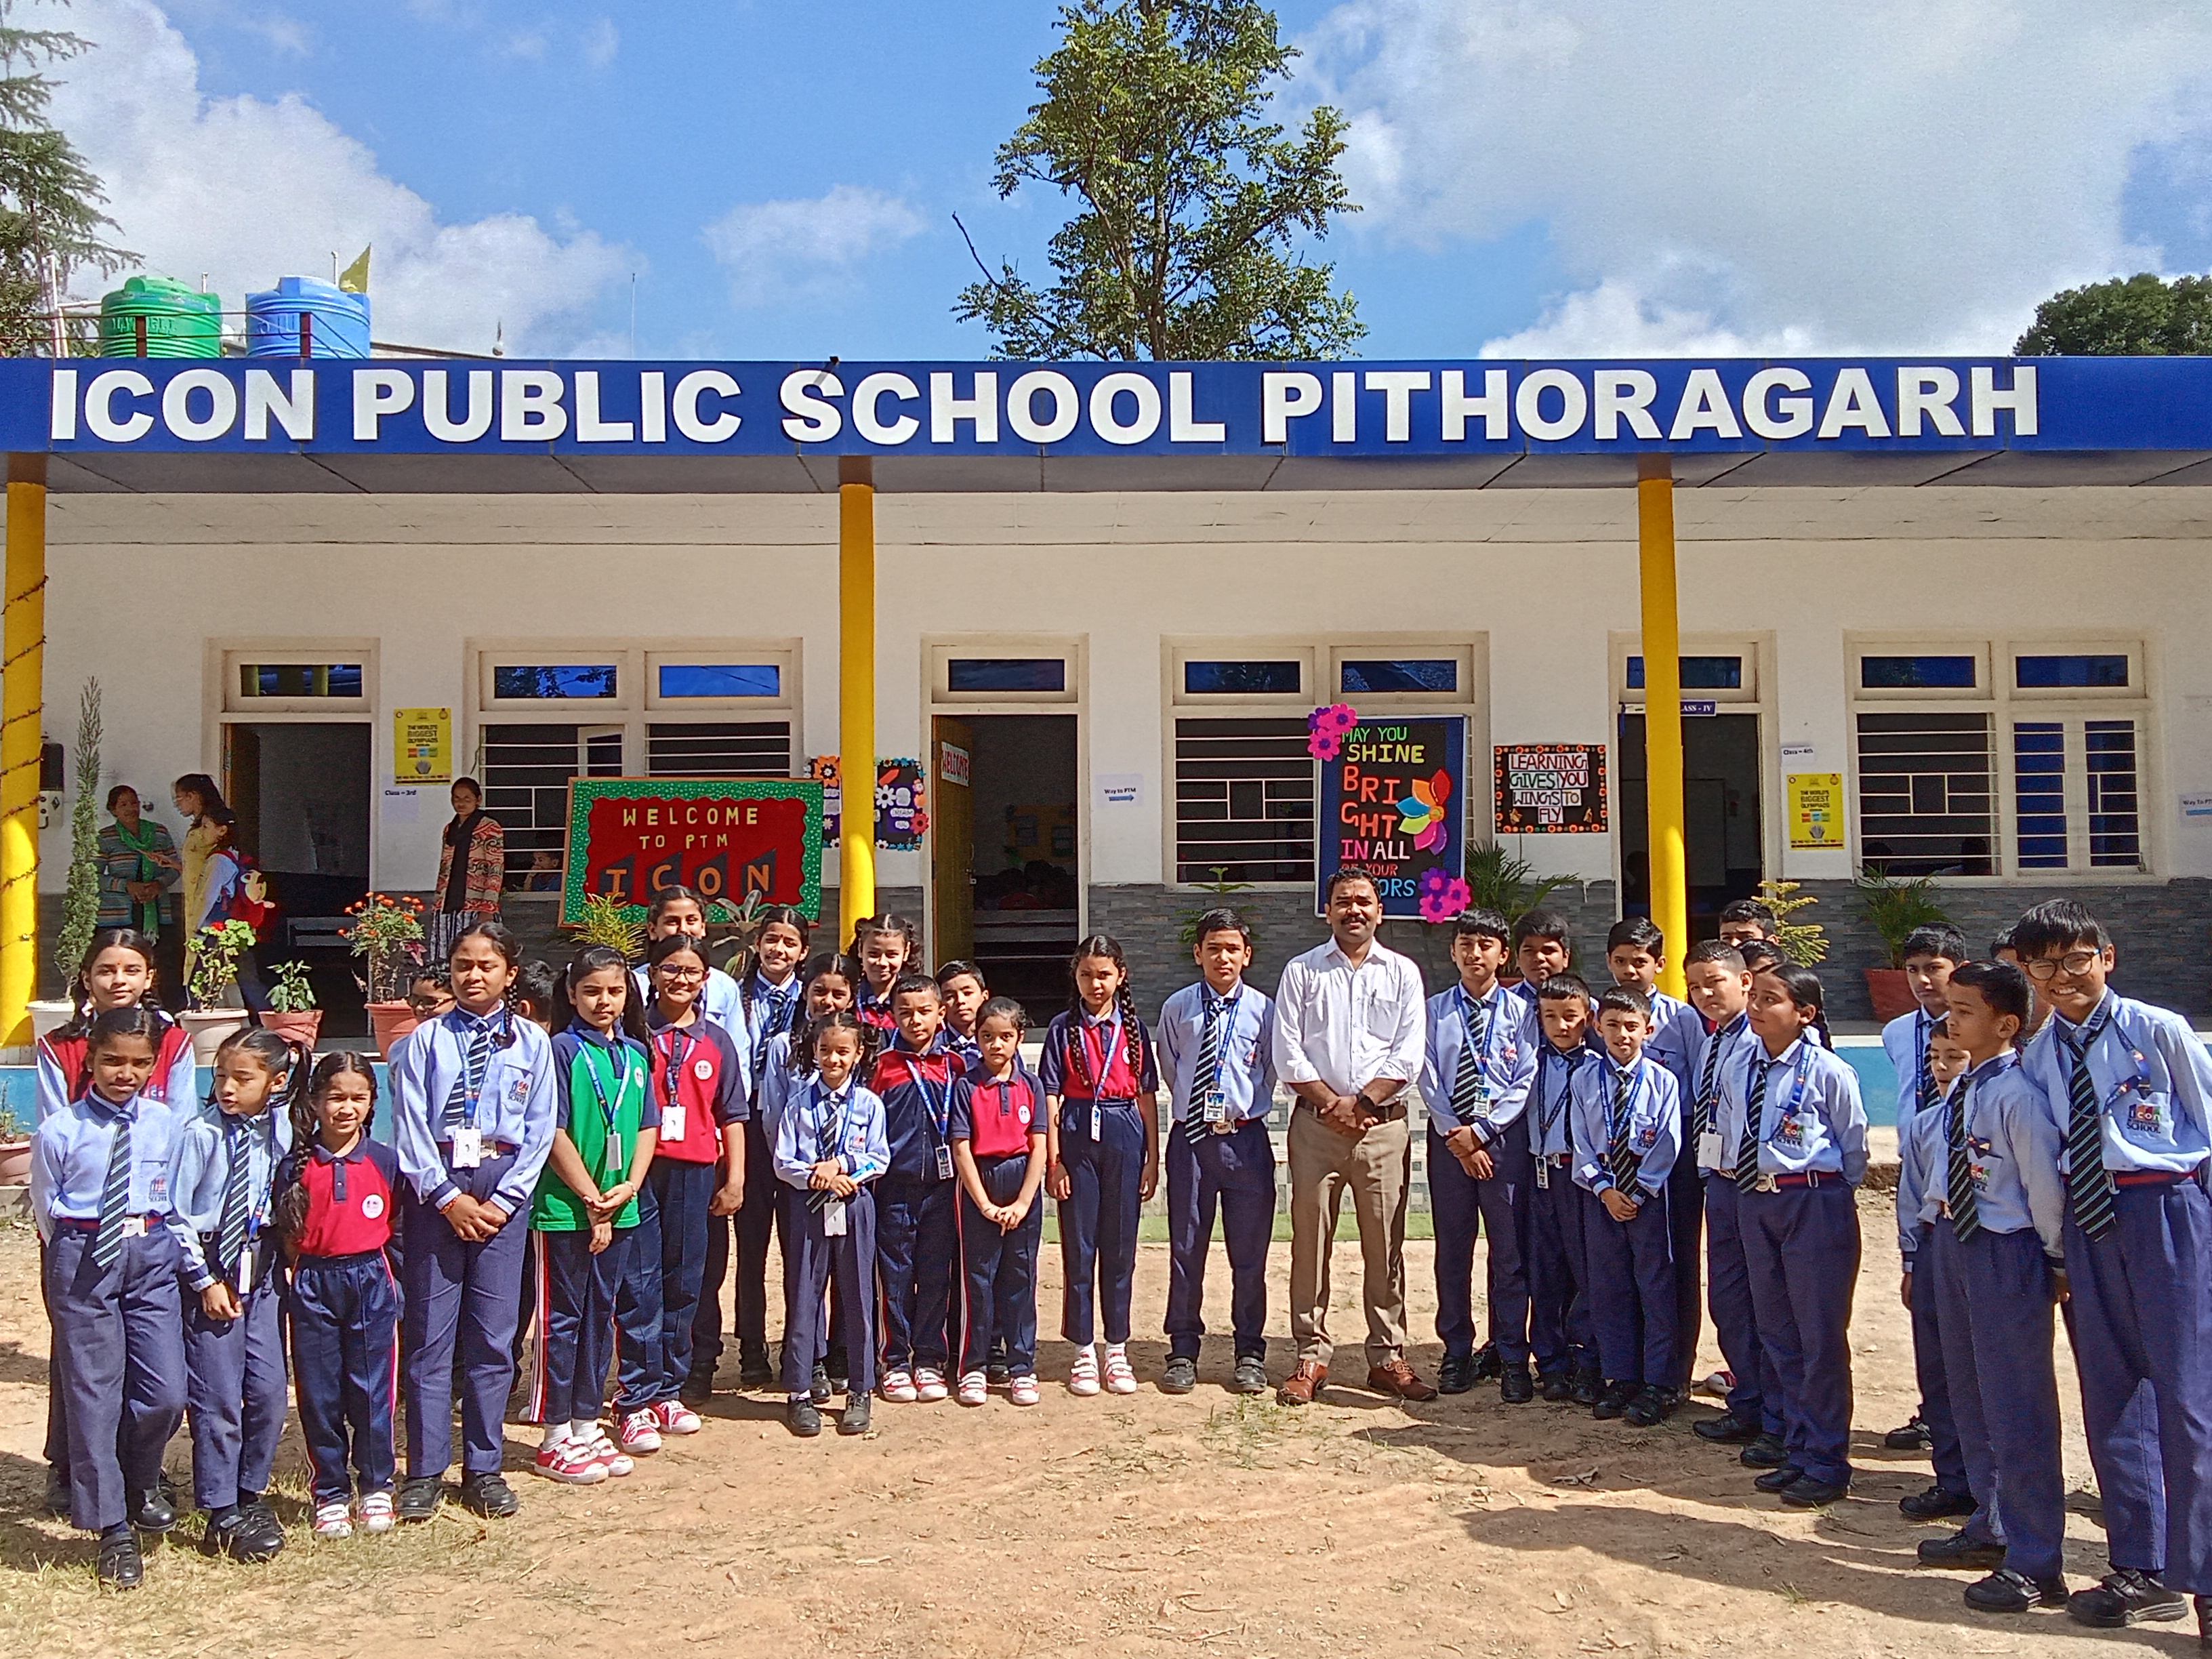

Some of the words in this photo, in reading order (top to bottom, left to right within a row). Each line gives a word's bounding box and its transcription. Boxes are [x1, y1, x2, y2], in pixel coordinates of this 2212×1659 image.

[51, 369, 314, 442] ICON
[353, 369, 741, 443] PUBLIC
[779, 370, 1225, 445] SCHOOL
[1263, 367, 2038, 442] PITHORAGARH
[1341, 727, 1370, 743] MAY
[1377, 726, 1408, 742] YOU
[1347, 743, 1425, 764] SHINE
[1511, 754, 1587, 770] LEARNING
[1510, 773, 1556, 790] GIVES
[1558, 772, 1587, 787] YOU
[1513, 792, 1561, 805] WINGS
[1562, 792, 1580, 805] TO
[623, 806, 758, 827] WELCOME
[1539, 807, 1561, 822] FLY
[639, 834, 665, 850] TO
[685, 833, 729, 849] PTM
[1340, 839, 1369, 860] IN
[1372, 840, 1410, 861] ALL
[1365, 863, 1399, 876] YOUR
[605, 864, 771, 897] ICON
[1378, 878, 1416, 897] ORS
[2127, 1122, 2161, 1134] SCHOOL
